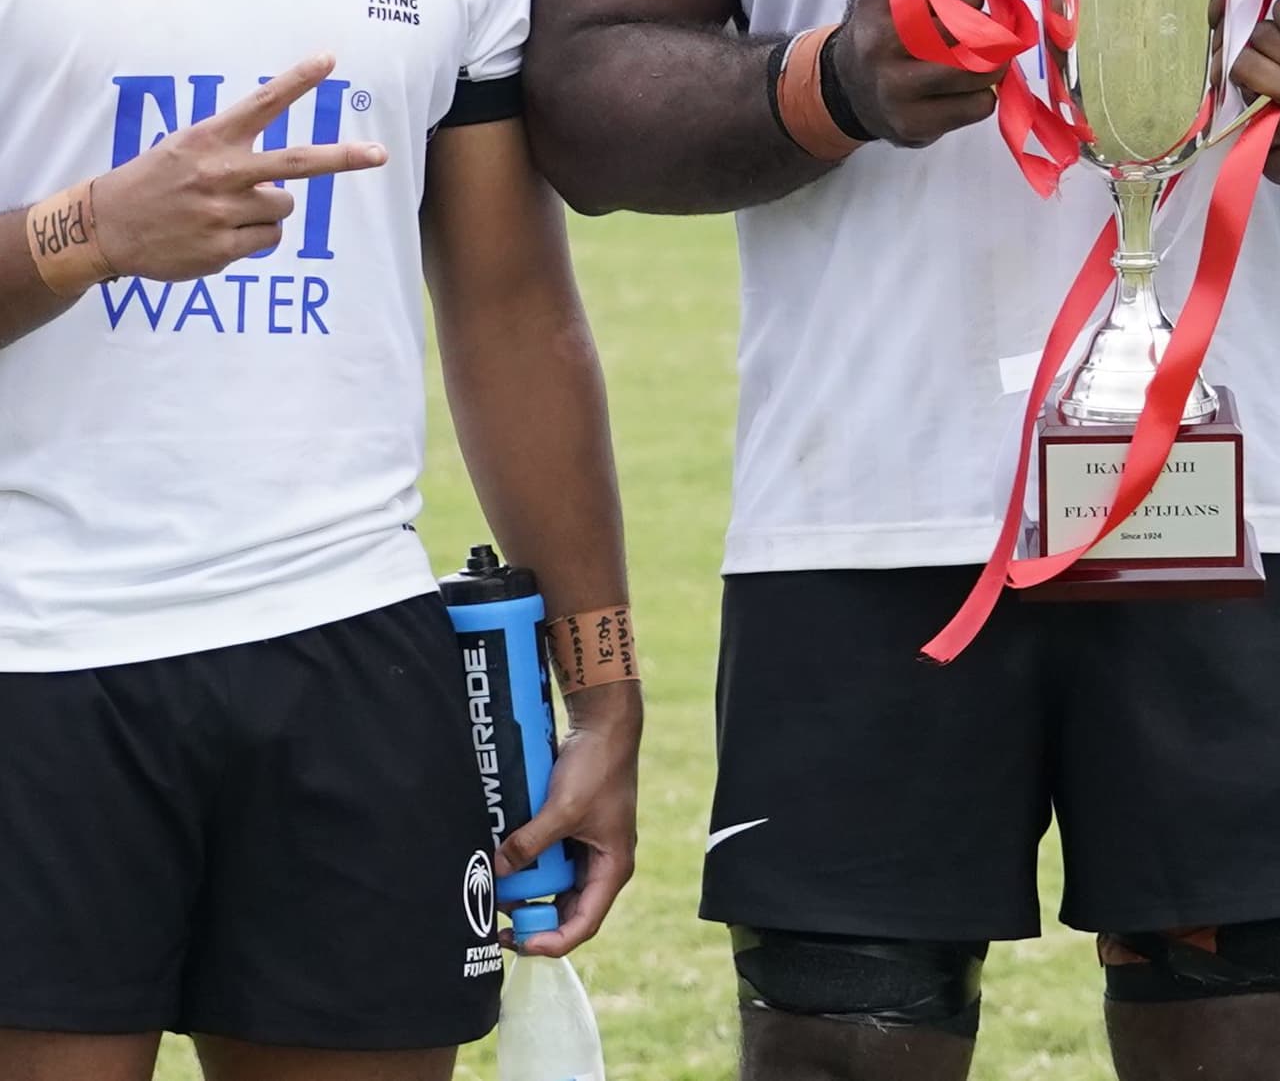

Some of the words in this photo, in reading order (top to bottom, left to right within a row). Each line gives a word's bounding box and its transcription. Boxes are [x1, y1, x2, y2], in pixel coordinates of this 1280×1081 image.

[368, 6, 421, 26] FIJIANS
[33, 200, 89, 256] PAPA
[100, 275, 330, 335] WATER
[1144, 504, 1220, 517] FIJIANS
[1121, 532, 1141, 541] Since
[1143, 531, 1162, 541] 1924
[463, 957, 502, 977] FIJIANS
